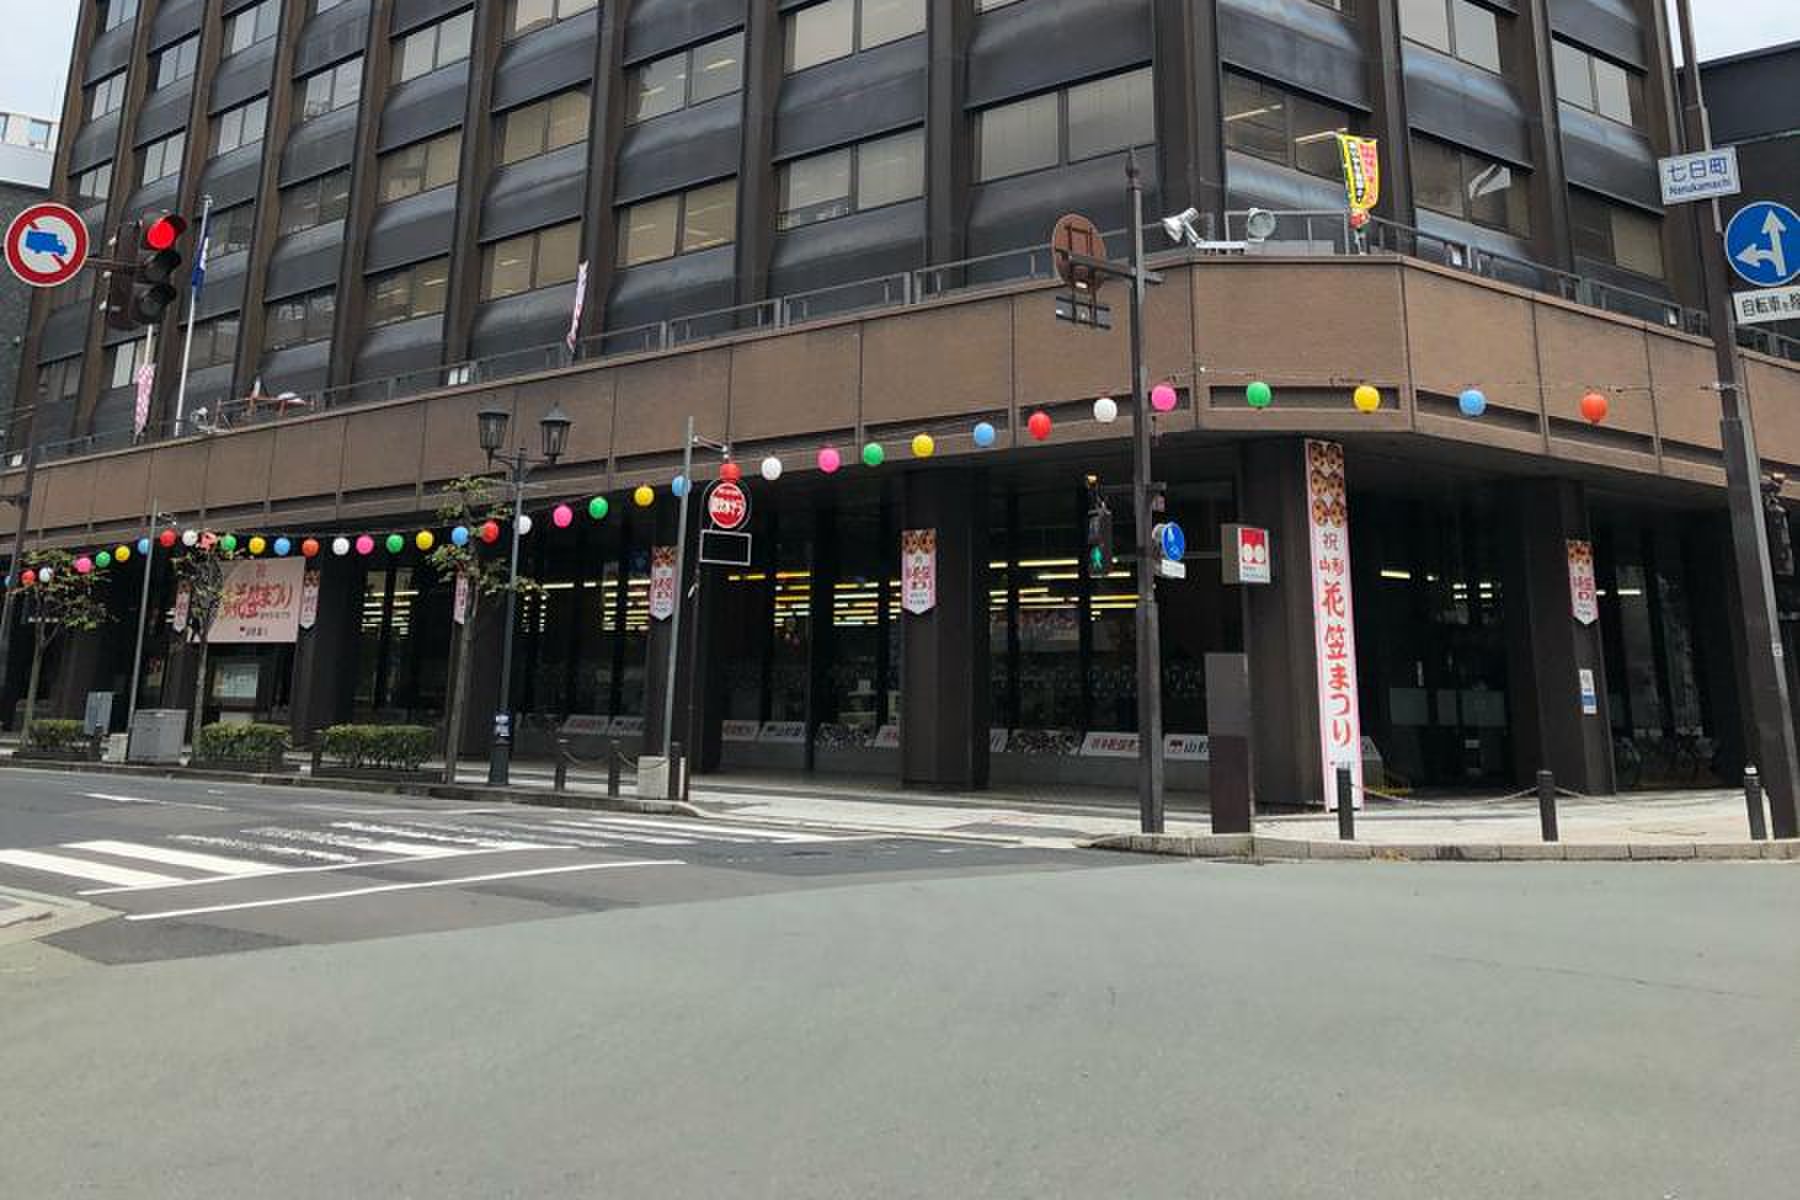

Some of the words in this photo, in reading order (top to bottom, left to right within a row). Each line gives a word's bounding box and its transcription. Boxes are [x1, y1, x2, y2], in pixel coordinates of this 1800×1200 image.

[1667, 157, 1728, 183] 七日町
[1320, 580, 1353, 747] 花笠まつり
